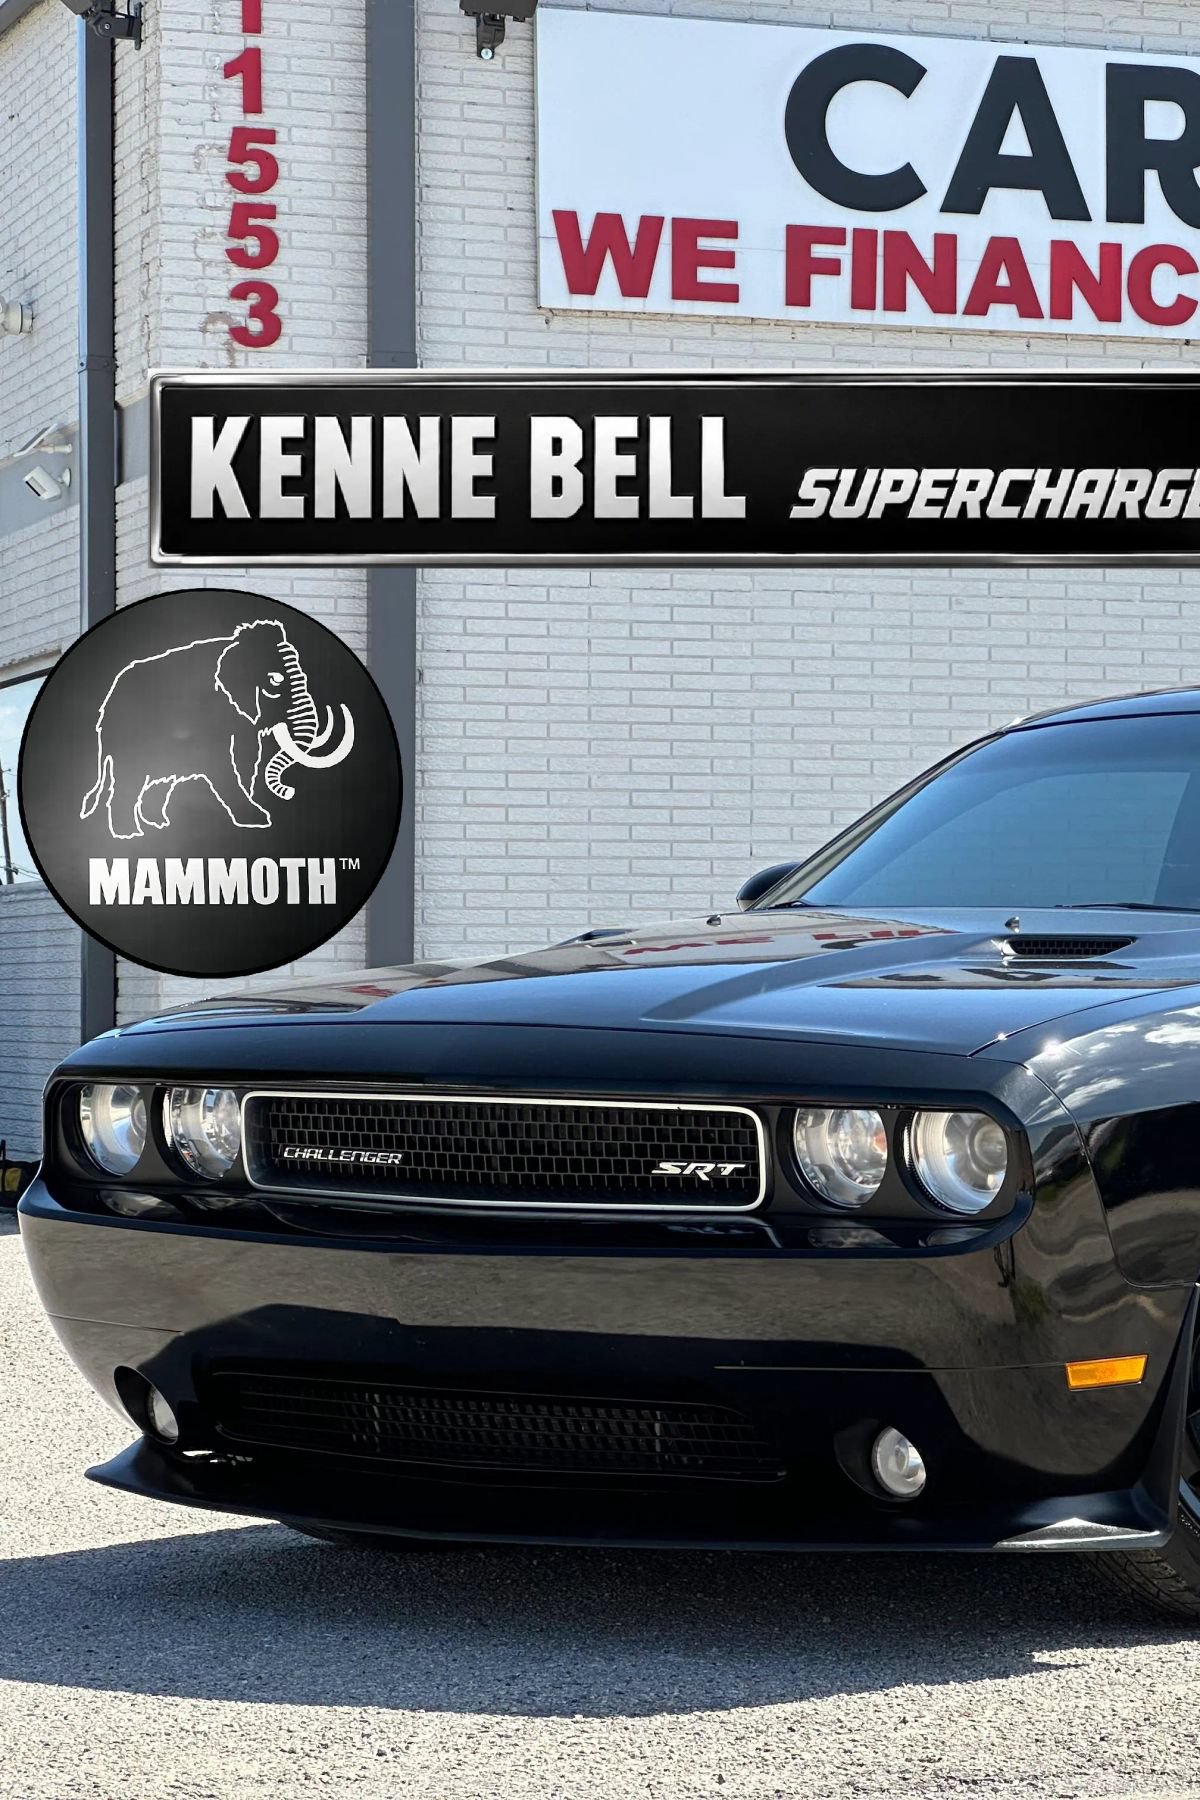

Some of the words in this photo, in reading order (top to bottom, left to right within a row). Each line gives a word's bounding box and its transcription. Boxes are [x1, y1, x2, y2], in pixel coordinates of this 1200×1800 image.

[552, 209, 740, 304] WE
[283, 1147, 403, 1165] CHALLENGER
[651, 1162, 747, 1181] SRT
